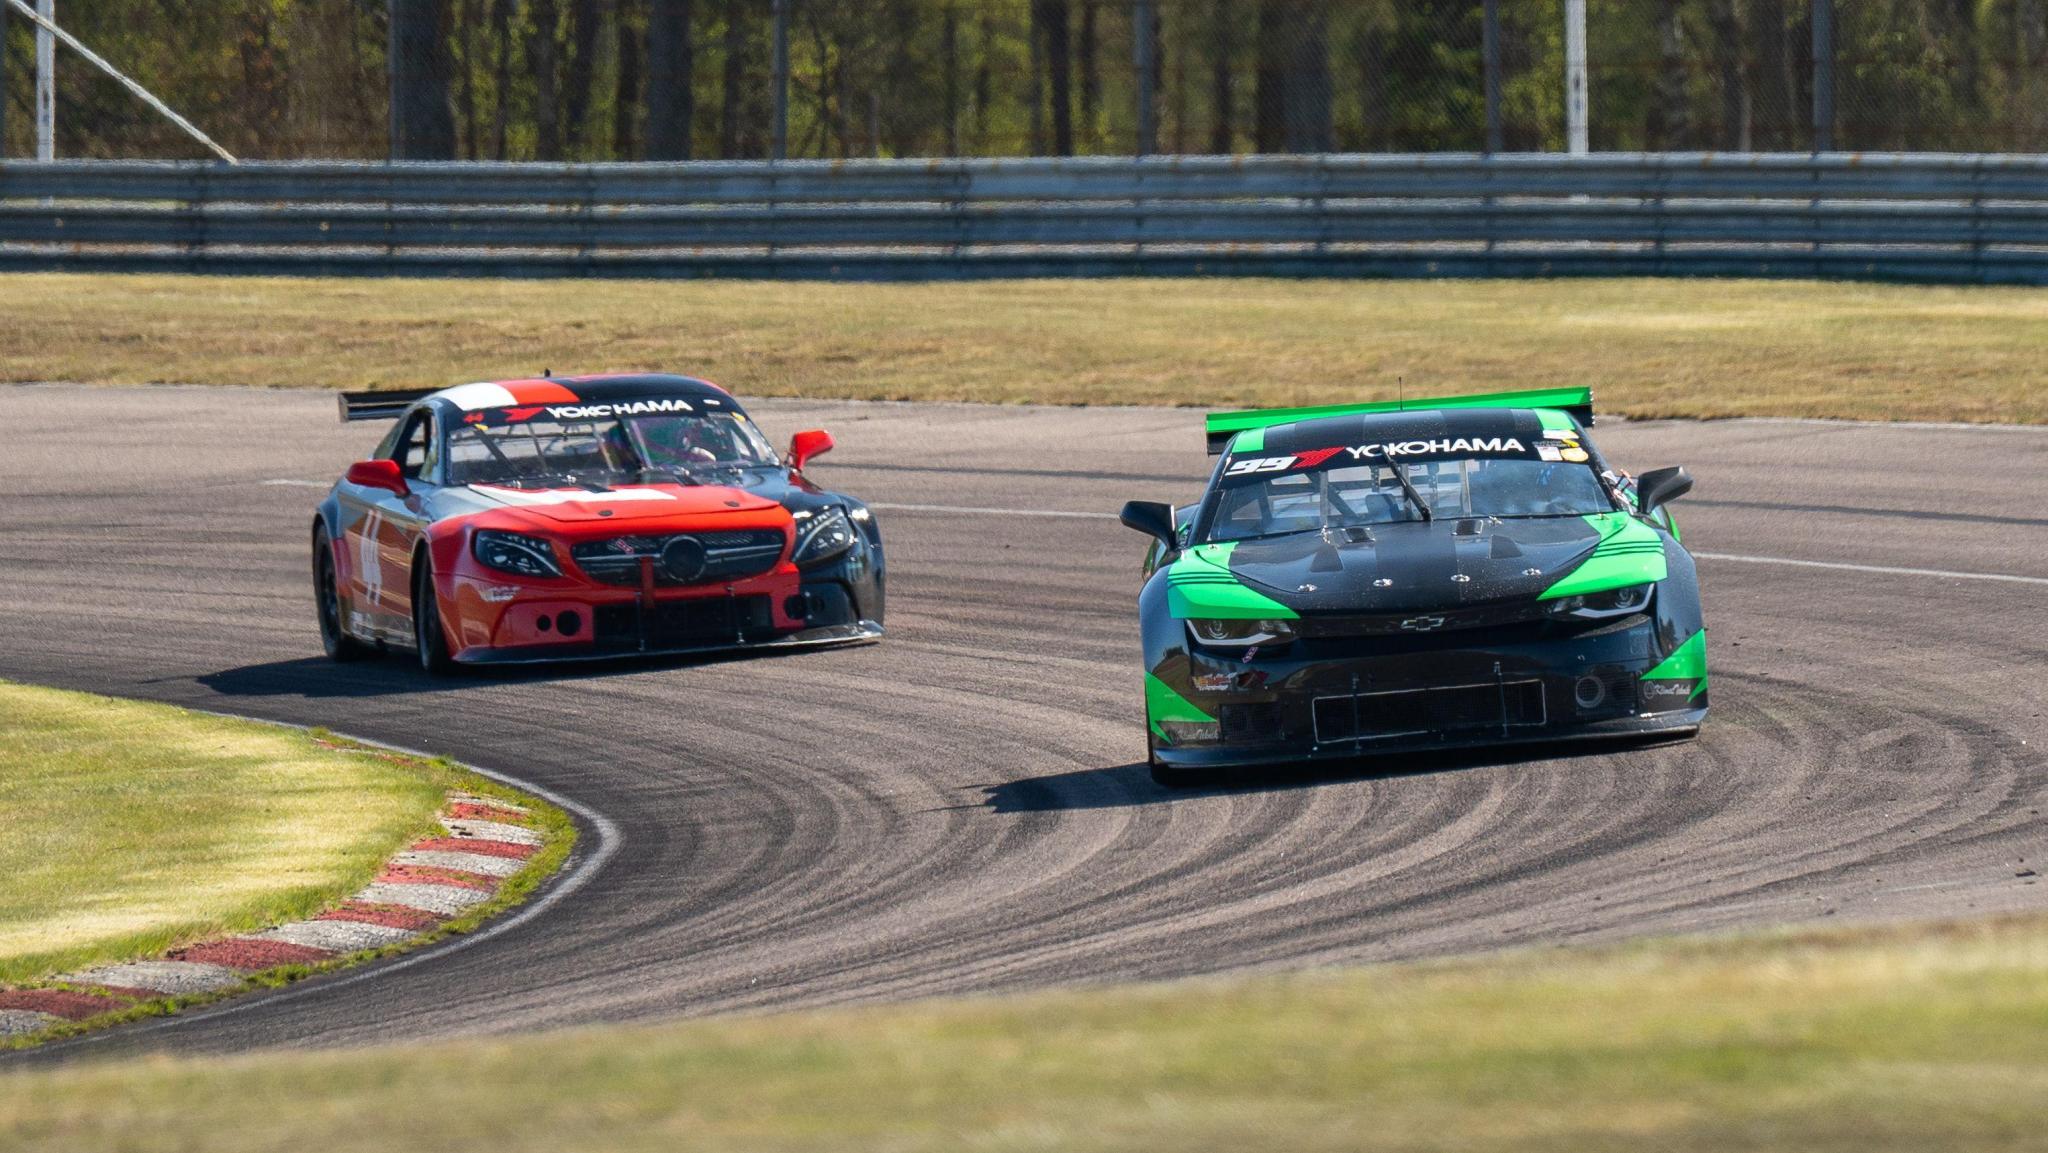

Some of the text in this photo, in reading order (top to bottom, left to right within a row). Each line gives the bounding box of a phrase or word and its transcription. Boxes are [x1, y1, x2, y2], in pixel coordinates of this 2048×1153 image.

[545, 399, 694, 418] YOKOHAMA
[1346, 441, 1526, 459] YOKOHAMA
[1225, 456, 1298, 476] 99
